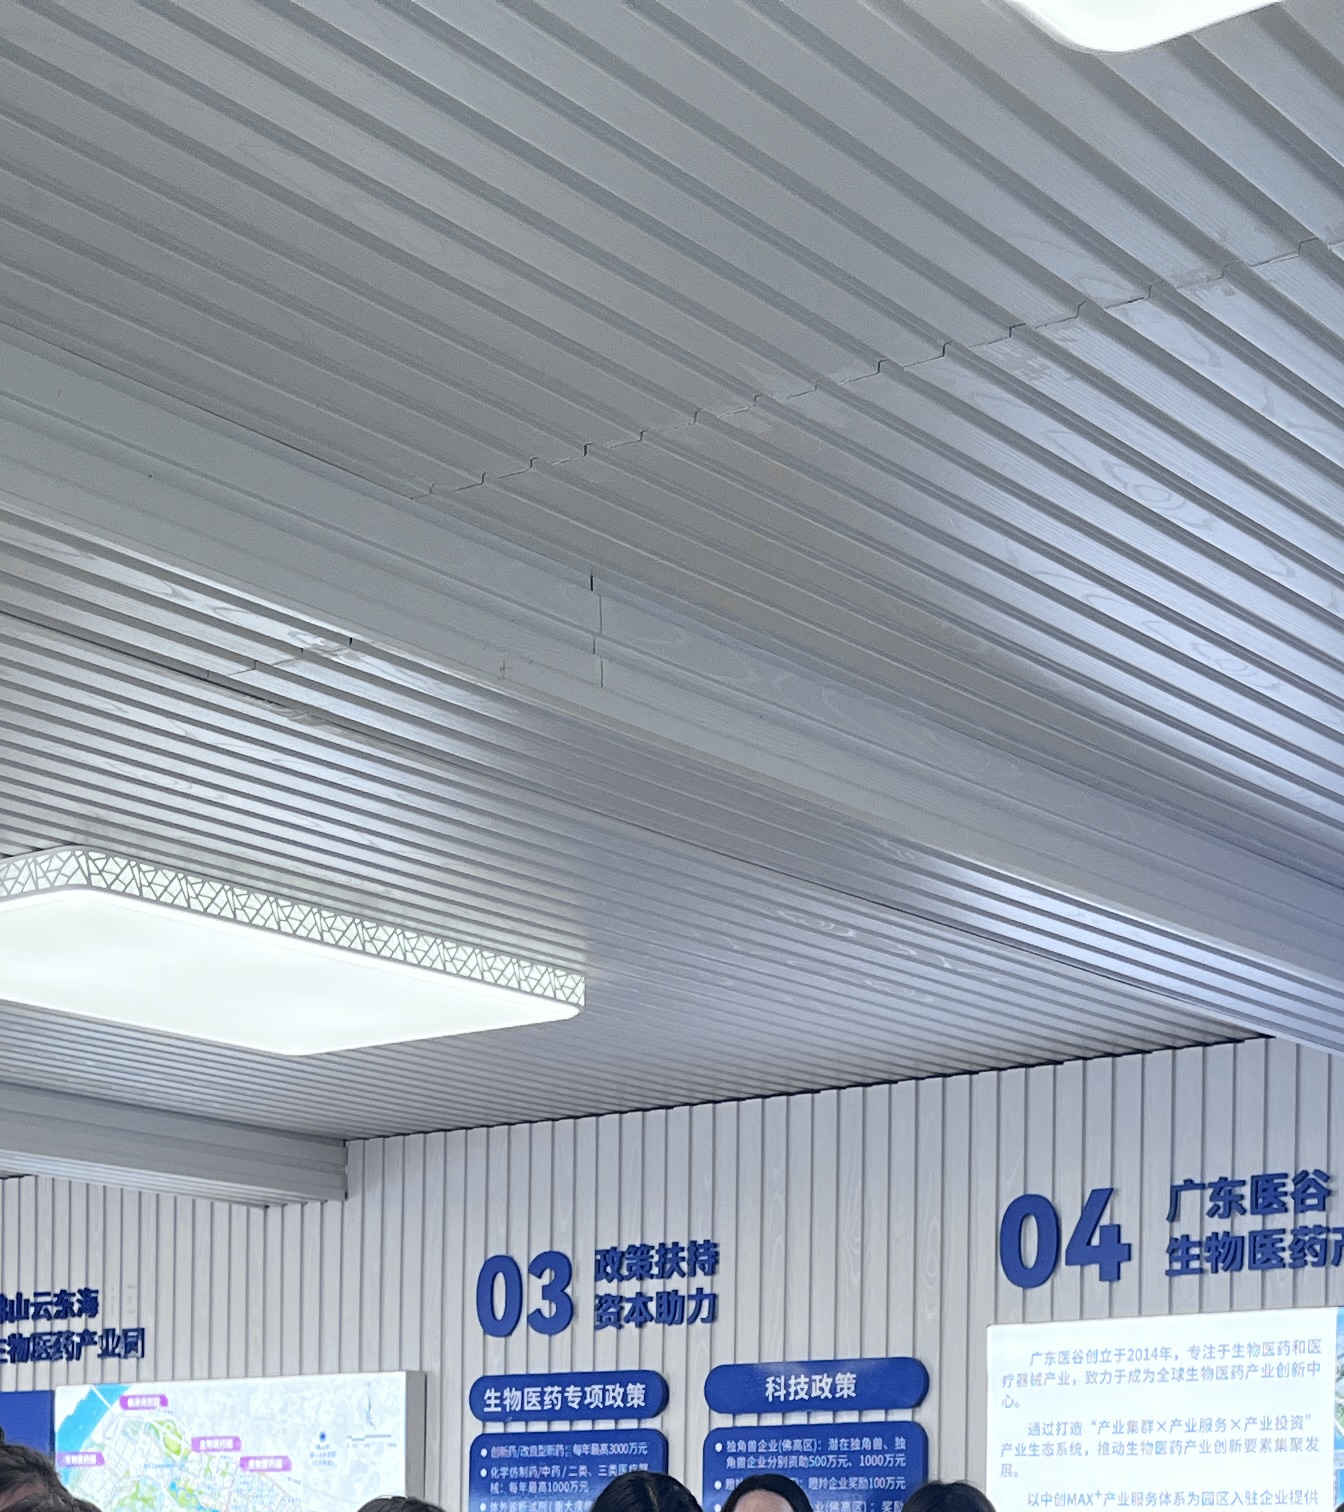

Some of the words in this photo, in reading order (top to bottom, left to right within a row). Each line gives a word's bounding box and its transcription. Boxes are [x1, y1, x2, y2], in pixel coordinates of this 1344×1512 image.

[1166, 1169, 1331, 1222] 广东医谷
[999, 1187, 1132, 1289] 04
[594, 1239, 720, 1283] 政策扶持
[476, 1250, 575, 1338] 03
[594, 1288, 719, 1331] 资本助力
[1029, 1338, 1323, 1366] 广东医谷创立于2014年，专注于生物医药和医
[764, 1372, 857, 1403] 科技政策
[1001, 1360, 1322, 1389] 疗器械产业，致力于成为全球生物医药产业创新中
[483, 1382, 647, 1413] 生物医药专项政策
[1001, 1394, 1020, 1409] 心。
[1000, 1436, 1320, 1458] 产业生态系统，推动生物医药产业创新要素集聚发
[1000, 1463, 1019, 1478] 展。
